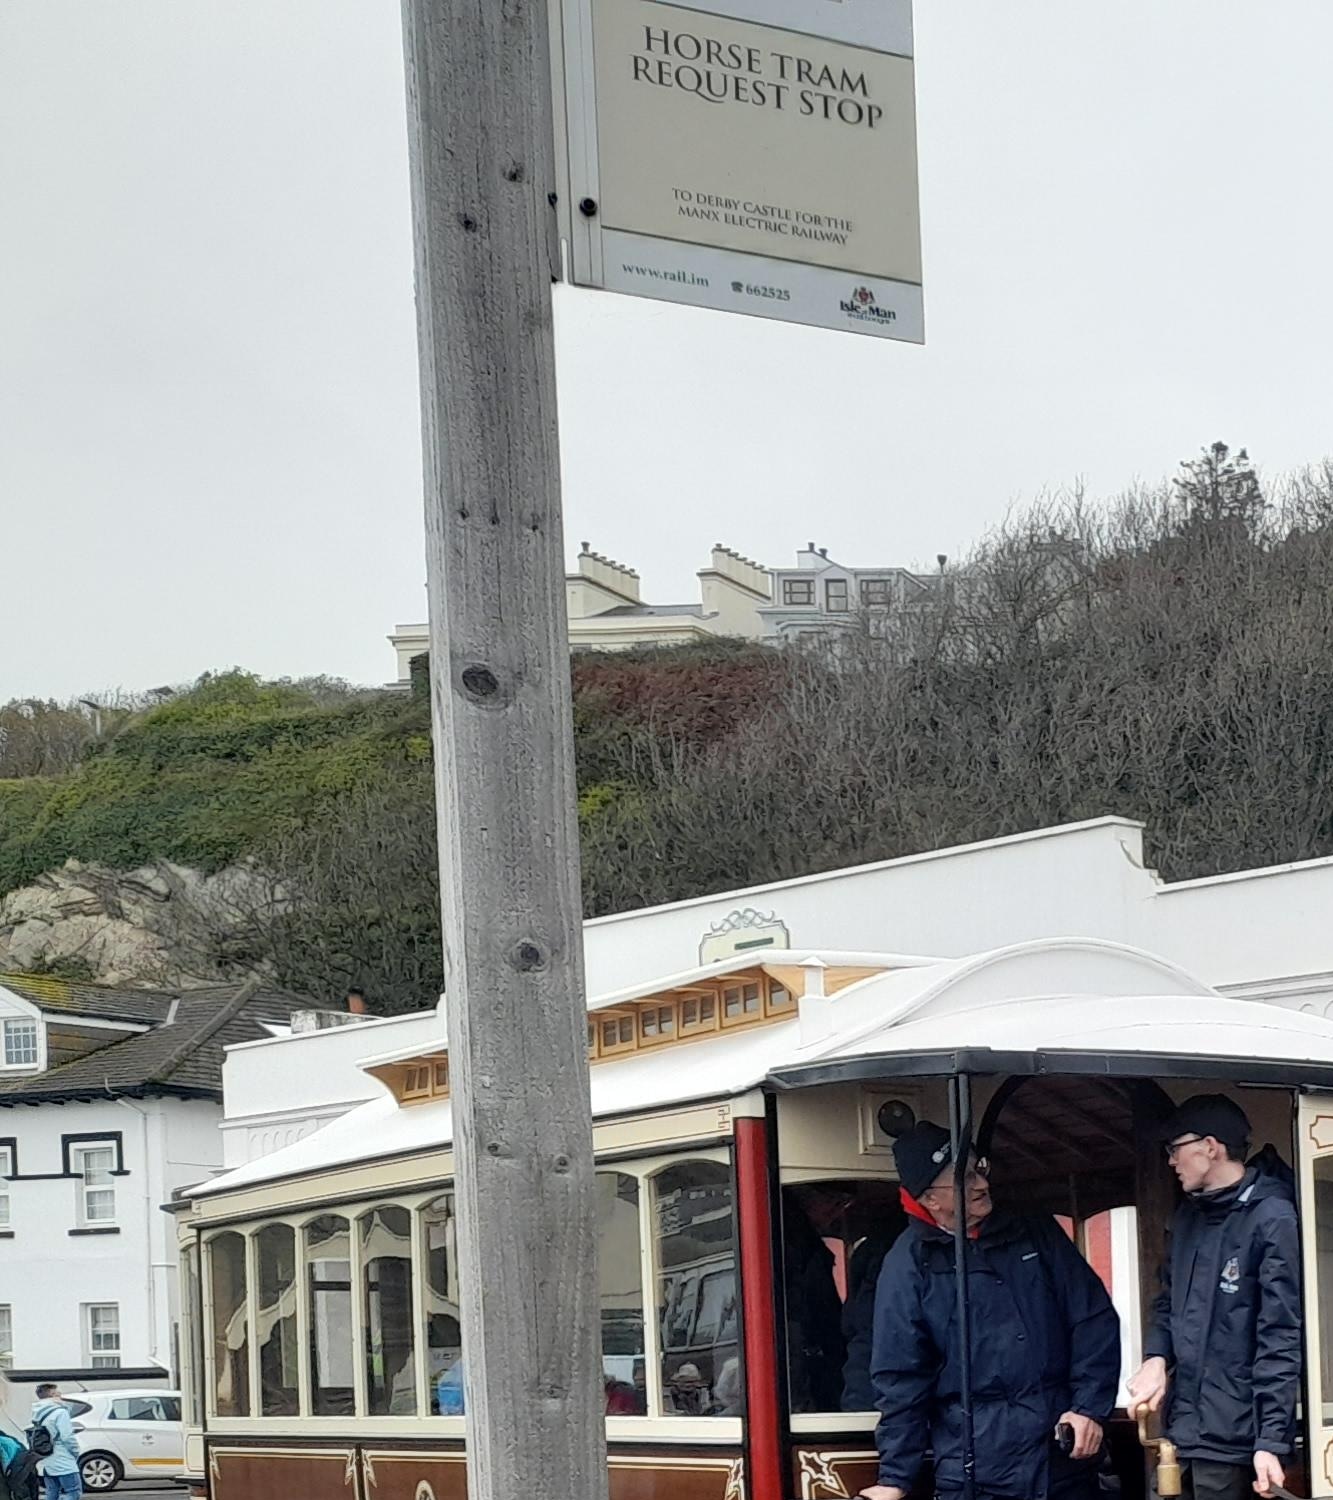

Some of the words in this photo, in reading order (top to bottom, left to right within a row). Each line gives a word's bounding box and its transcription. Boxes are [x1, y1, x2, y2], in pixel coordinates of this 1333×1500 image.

[643, 25, 762, 74] HORSE
[771, 52, 870, 97] TRAM
[631, 55, 789, 110] REQUEST
[799, 90, 883, 129] STOP
[672, 188, 692, 202] TO
[695, 192, 740, 212] DERBY
[743, 201, 792, 221] CASTLE
[795, 210, 823, 226] FOR
[824, 215, 853, 233] THE
[677, 205, 721, 223] MANX
[723, 213, 788, 235] ELECTRIC
[791, 225, 849, 246] RAILWAY
[621, 263, 709, 288] www.rail.im
[745, 284, 790, 301] 662525
[840, 300, 861, 313] Isle
[869, 306, 896, 320] Man
